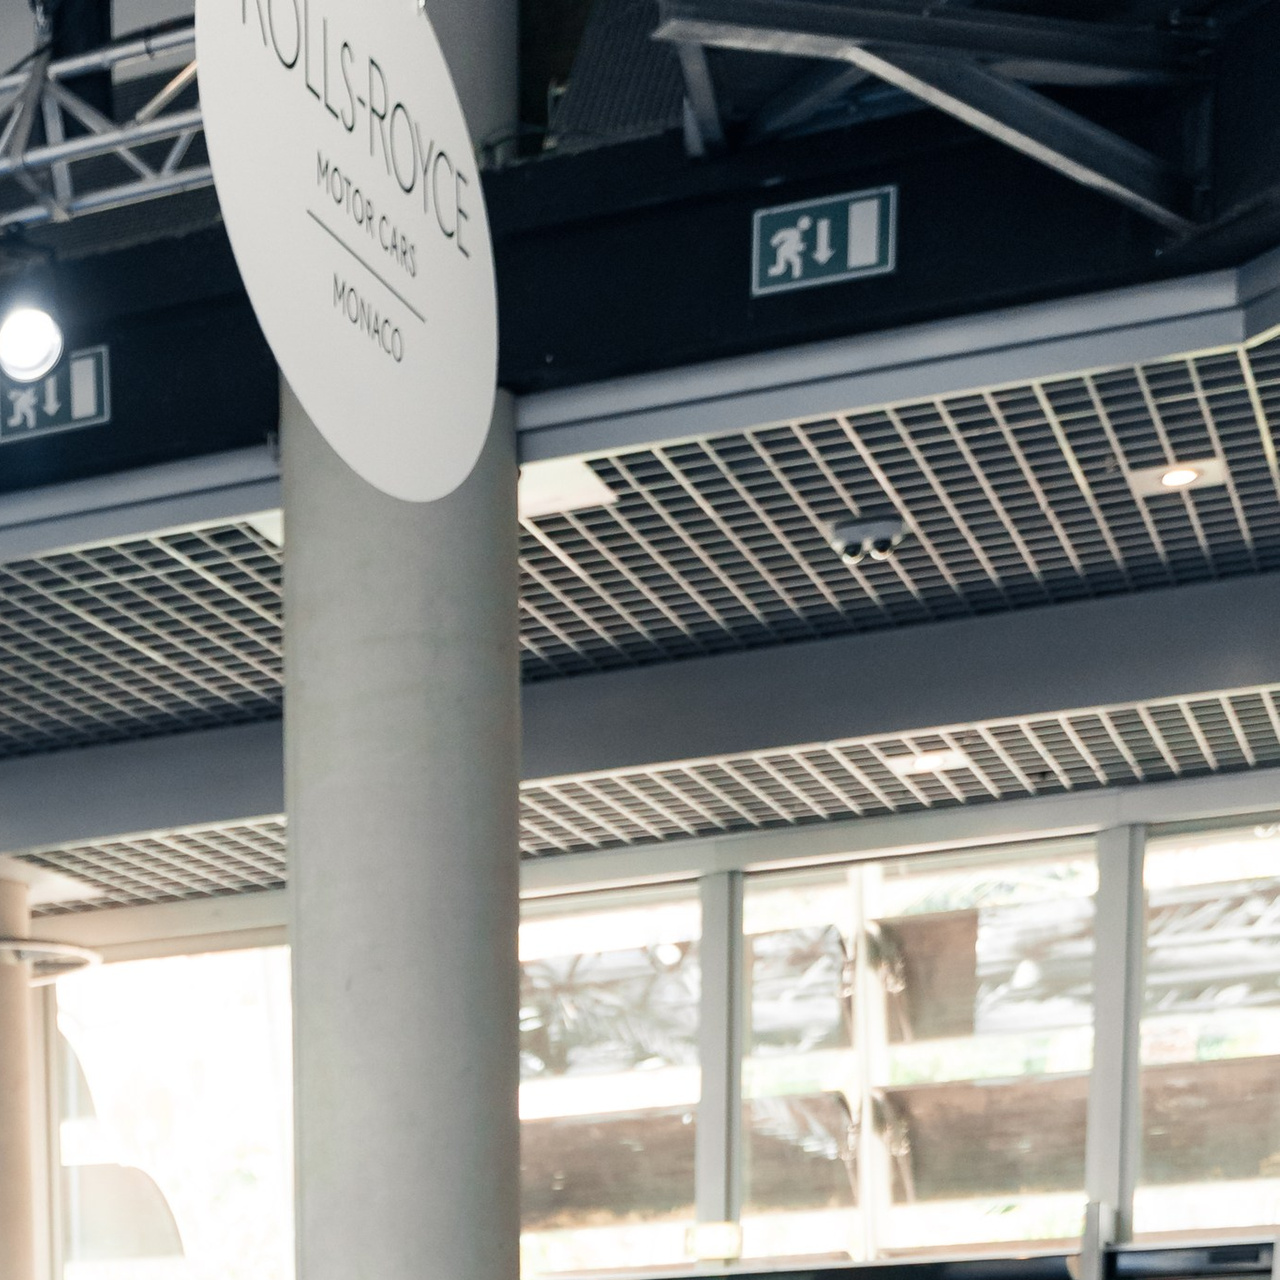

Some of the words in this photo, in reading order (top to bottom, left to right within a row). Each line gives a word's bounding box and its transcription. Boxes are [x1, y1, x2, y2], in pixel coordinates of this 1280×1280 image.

[316, 150, 375, 239] MOTOR
[378, 214, 417, 279] CARS
[332, 272, 405, 363] MONACO
